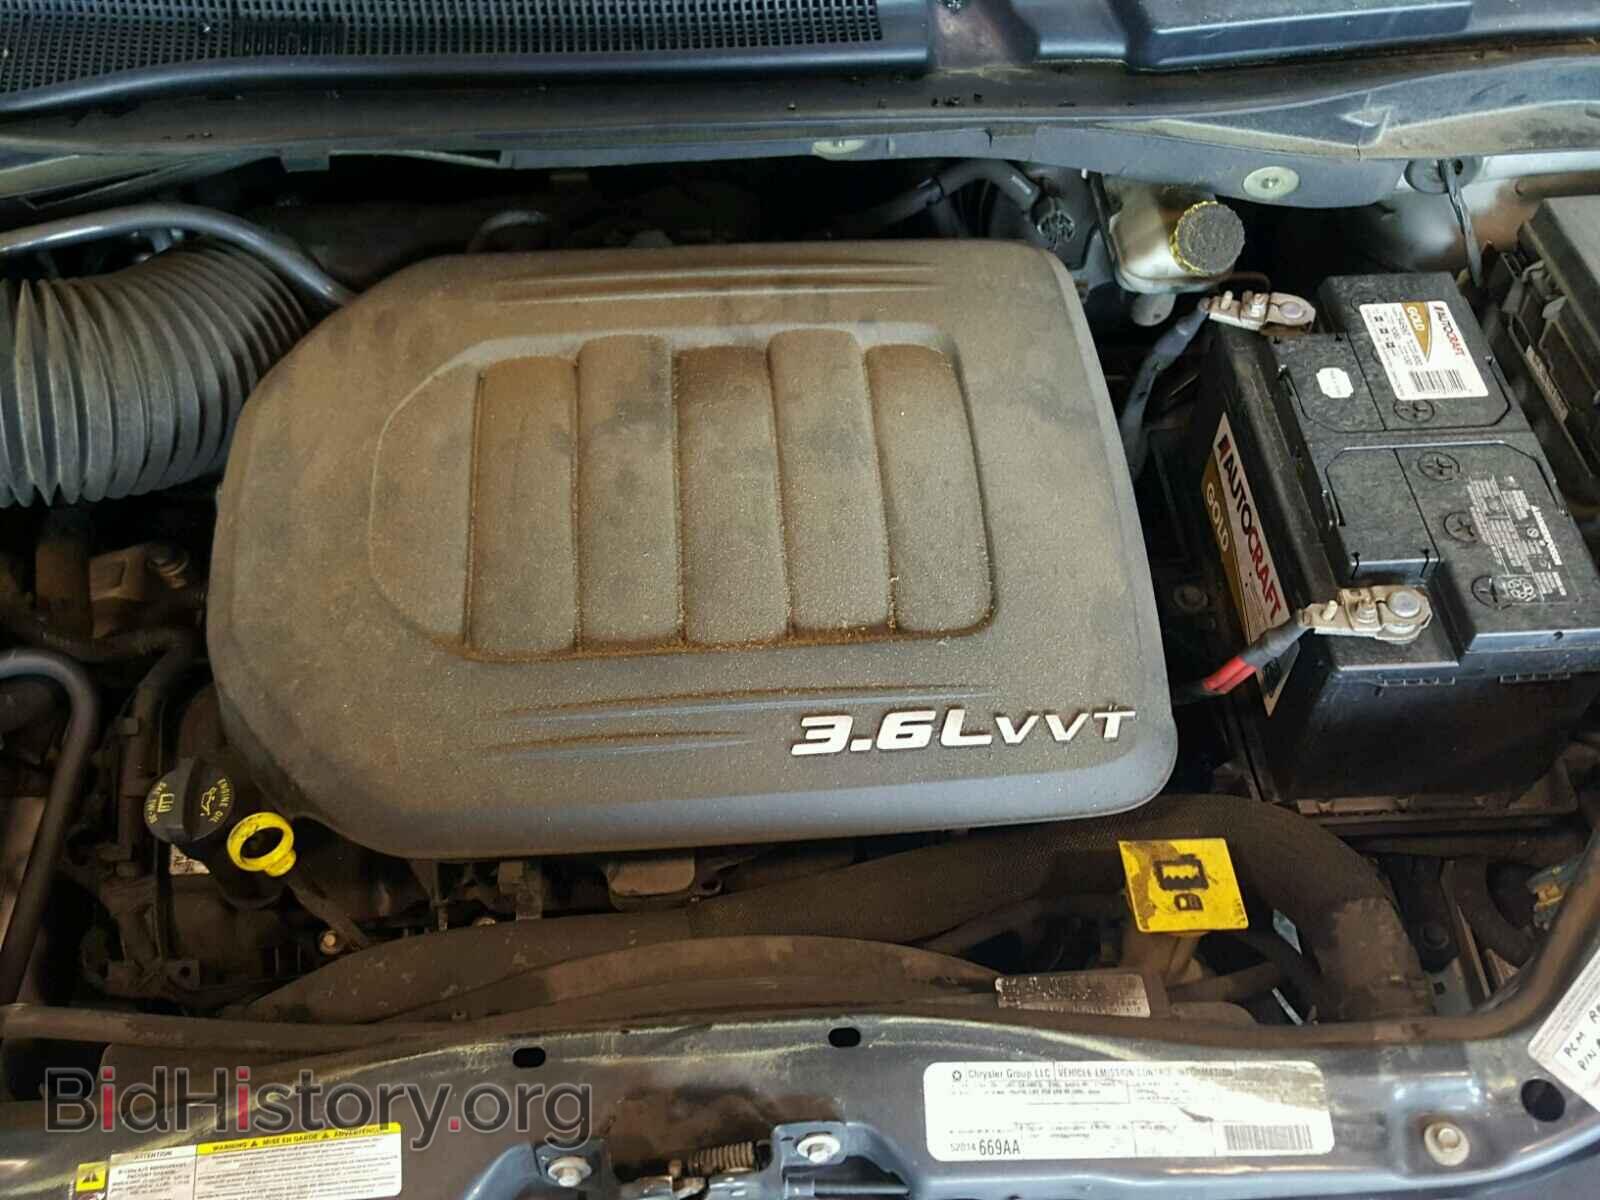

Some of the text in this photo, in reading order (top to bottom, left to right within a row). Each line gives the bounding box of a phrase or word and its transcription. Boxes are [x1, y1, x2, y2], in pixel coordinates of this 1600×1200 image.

[1406, 306, 1425, 332] GOLD
[1435, 308, 1466, 357] AUTOCRAFT
[1206, 482, 1230, 552] GOLD
[1220, 447, 1281, 620] AUTOCRAFT
[968, 1068, 1050, 1081] Chrysler Group LLC
